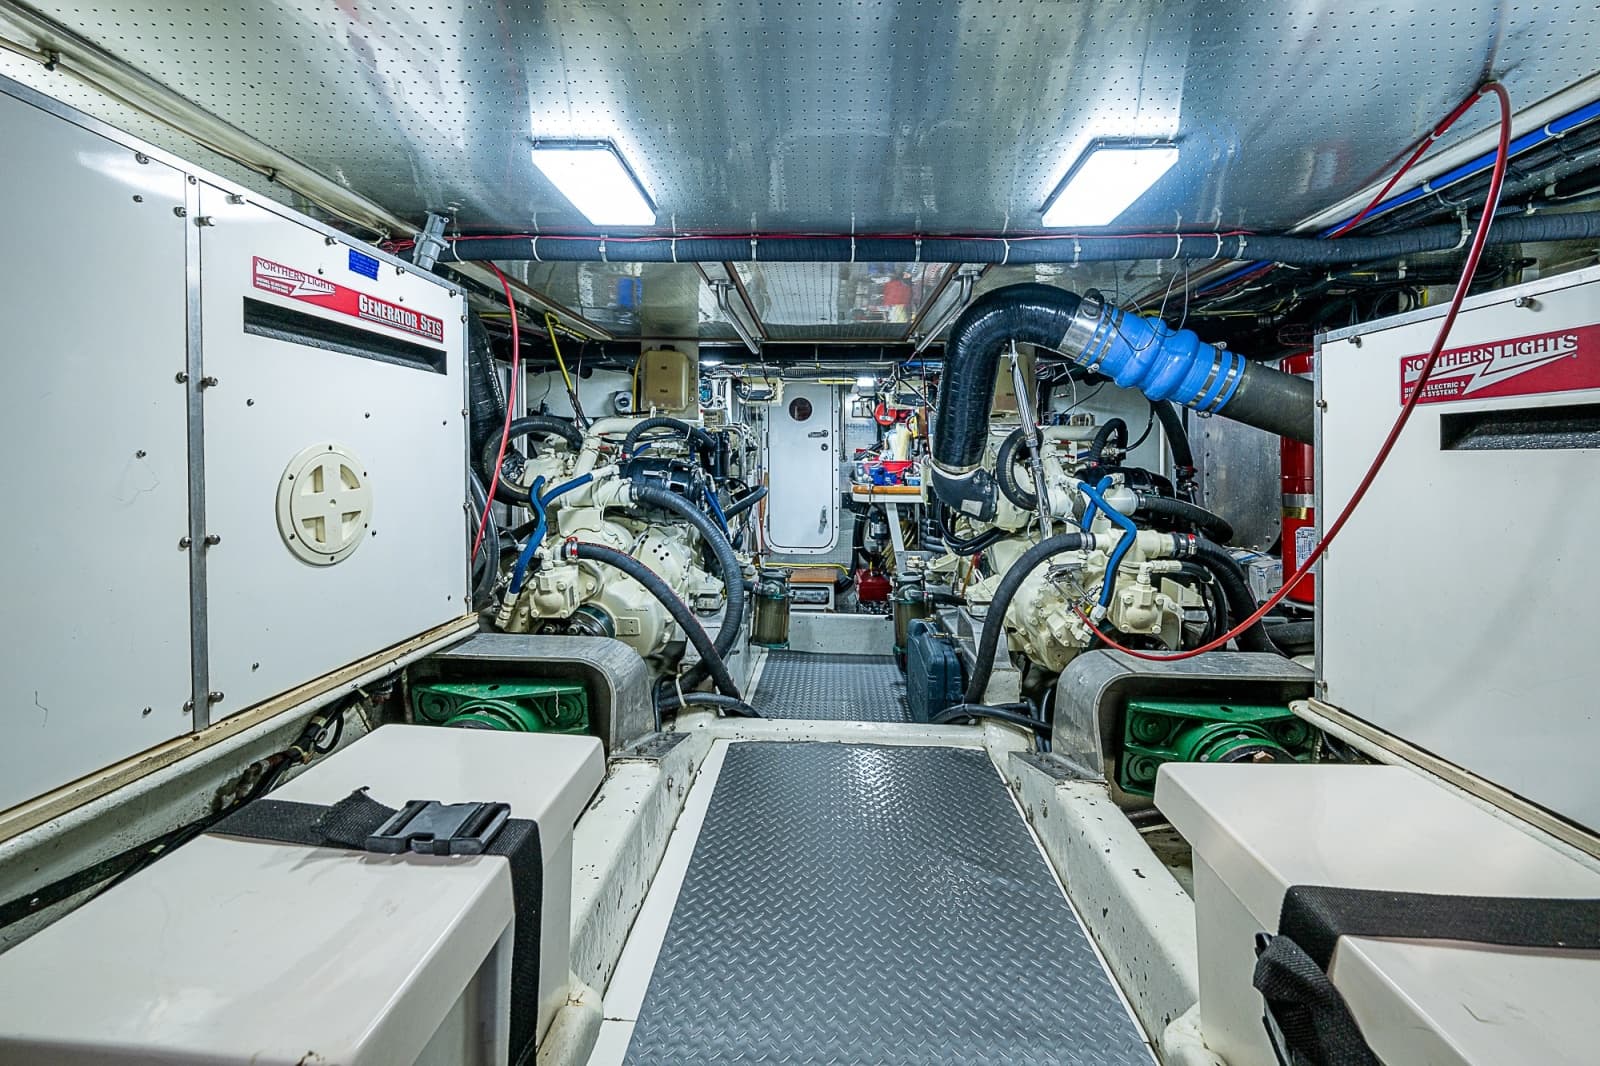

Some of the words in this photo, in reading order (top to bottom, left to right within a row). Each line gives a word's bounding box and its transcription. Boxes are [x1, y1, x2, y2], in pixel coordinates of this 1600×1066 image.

[255, 260, 306, 281] NORTHERN
[307, 276, 336, 292] LIGHTS
[359, 294, 417, 329] GENERATOR
[421, 314, 441, 337] SETS
[1405, 347, 1494, 372] NOTHERN
[1501, 334, 1577, 359] LIGHTS
[1427, 381, 1459, 391] ELECTRIC
[1427, 388, 1458, 397] SYSTEMS
